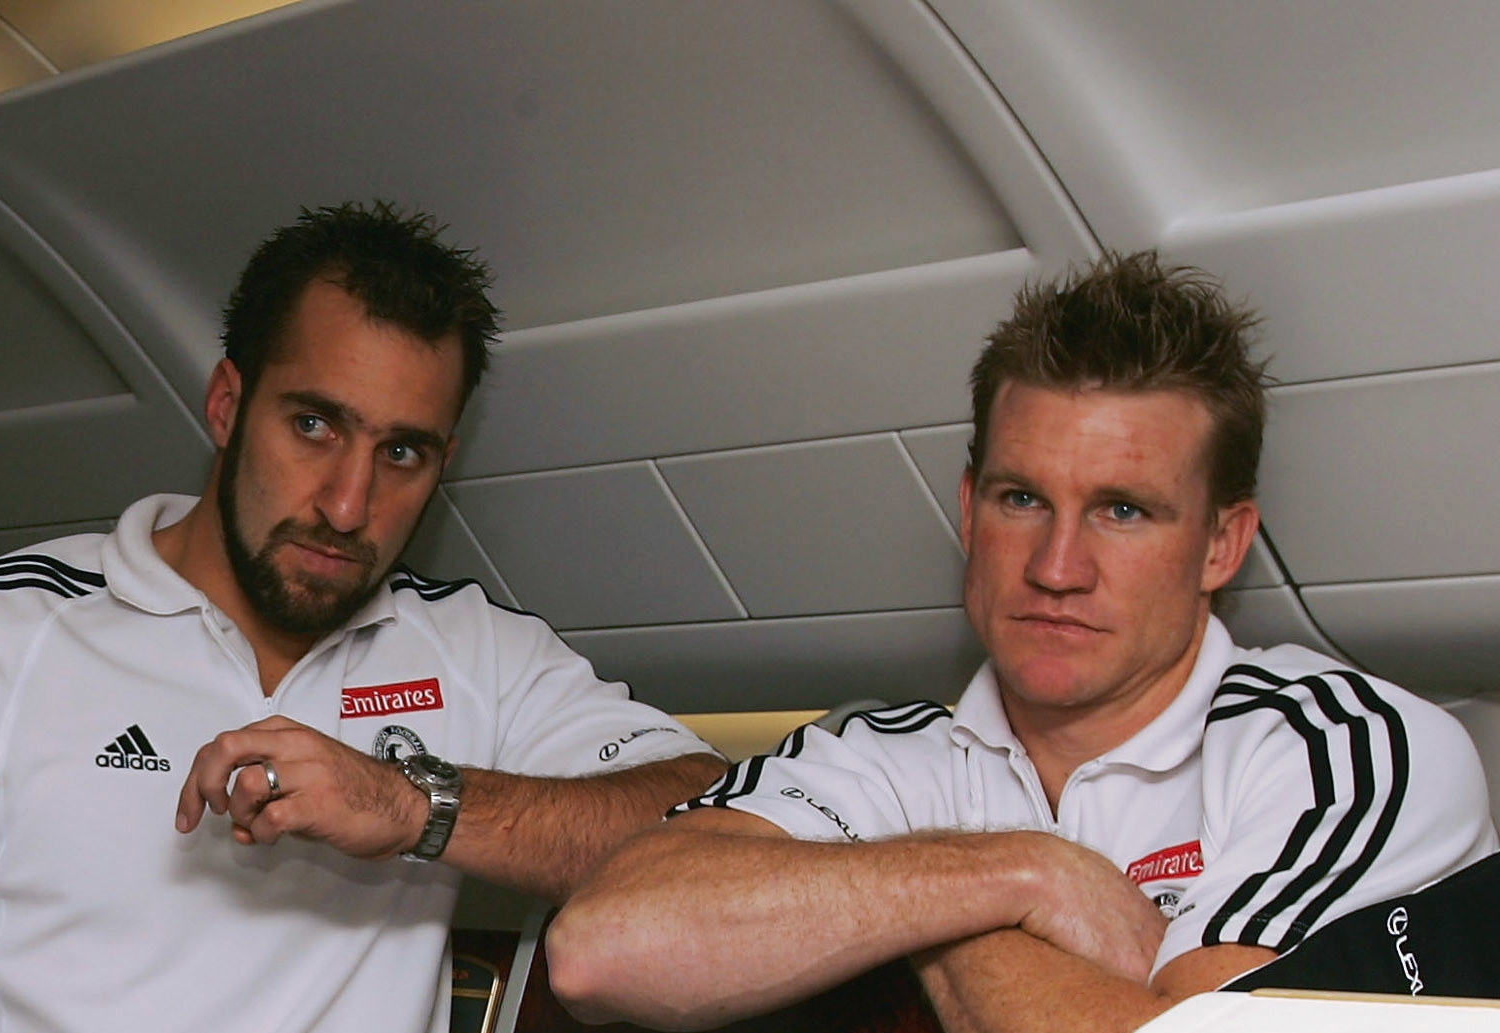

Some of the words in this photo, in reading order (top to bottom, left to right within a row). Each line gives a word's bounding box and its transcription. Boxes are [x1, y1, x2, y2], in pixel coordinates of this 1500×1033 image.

[341, 687, 436, 714] Emirates
[95, 752, 171, 772] adidas
[806, 798, 860, 842] LEXU
[1127, 850, 1204, 881] Emirate
